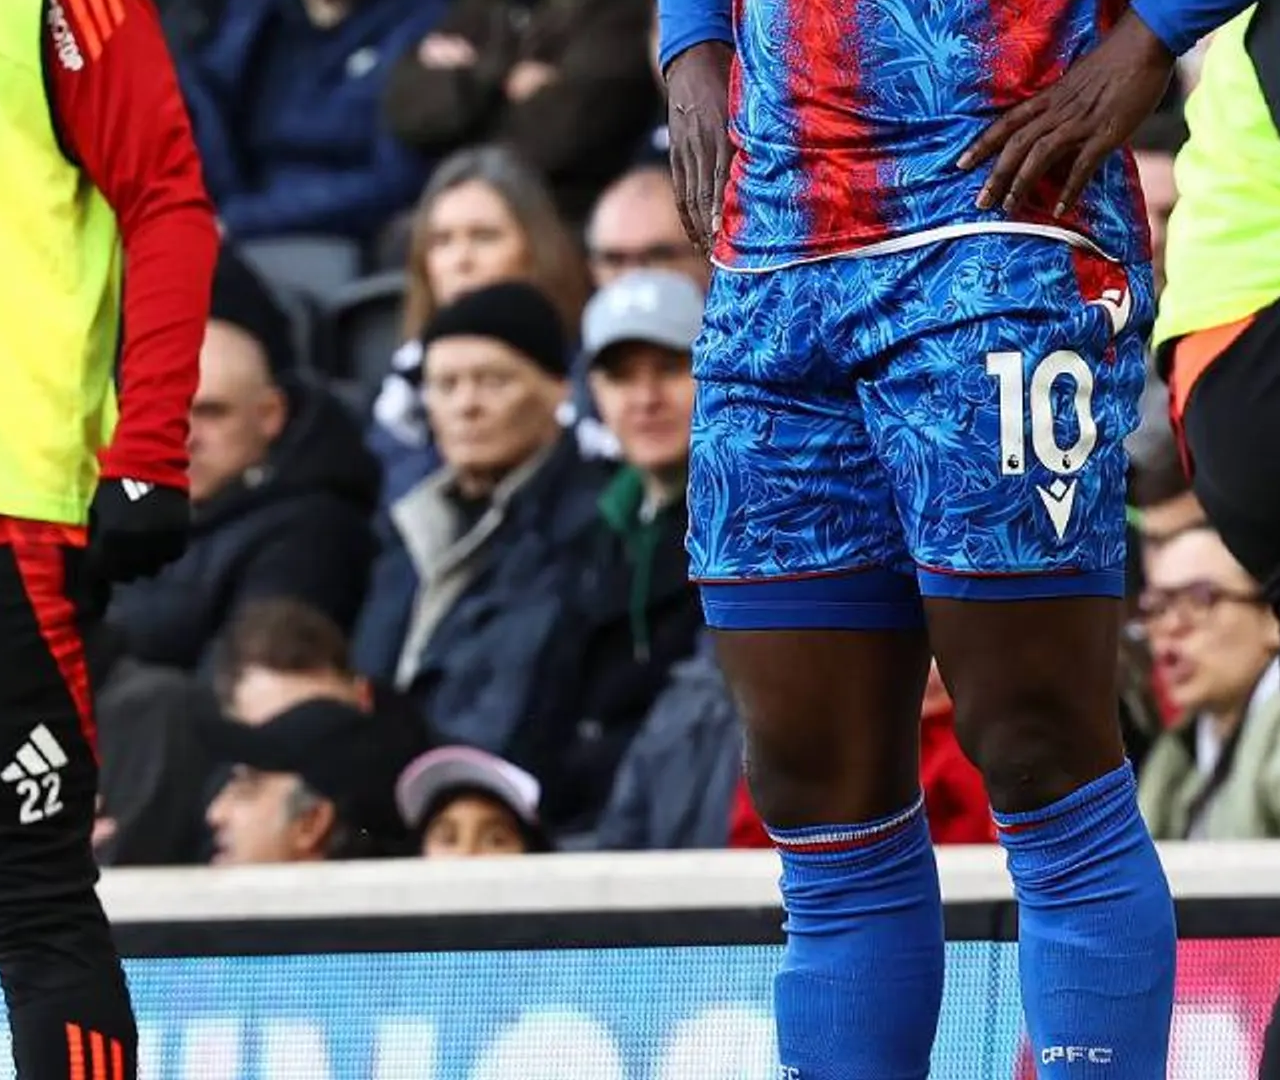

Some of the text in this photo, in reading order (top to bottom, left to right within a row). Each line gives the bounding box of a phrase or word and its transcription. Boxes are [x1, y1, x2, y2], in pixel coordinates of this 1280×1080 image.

[986, 350, 1098, 475] 10
[16, 771, 64, 824] 22
[1041, 1046, 1113, 1064] CPFC
